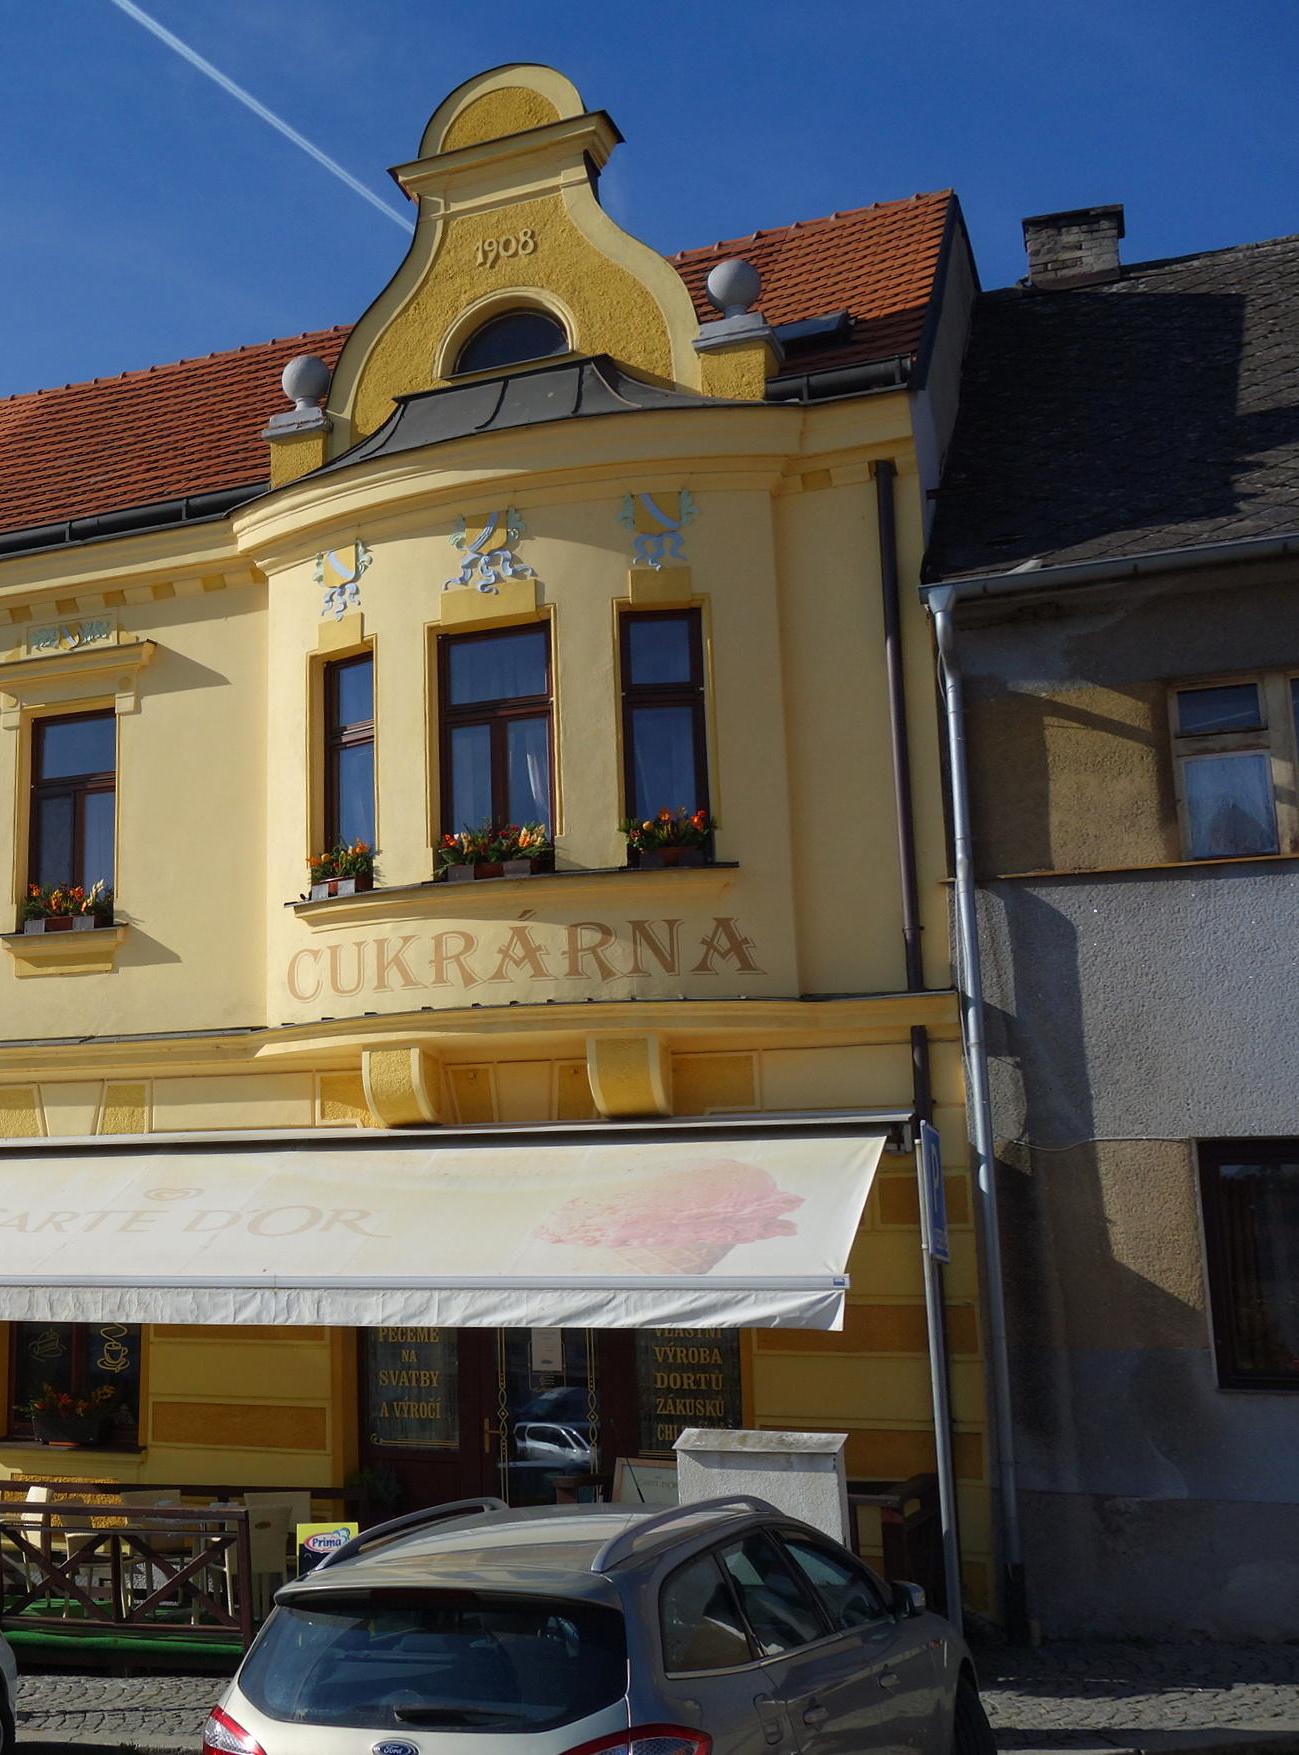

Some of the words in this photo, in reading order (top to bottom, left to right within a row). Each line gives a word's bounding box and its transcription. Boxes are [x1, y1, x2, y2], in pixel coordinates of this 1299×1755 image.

[476, 228, 535, 268] 1908
[286, 909, 769, 1004] CUKRÁRNA
[401, 1349, 418, 1363] NA
[653, 1342, 723, 1365] VÝROBA
[379, 1370, 440, 1387] SVATBY
[381, 1401, 390, 1418] A
[312, 1536, 342, 1547] Prima
